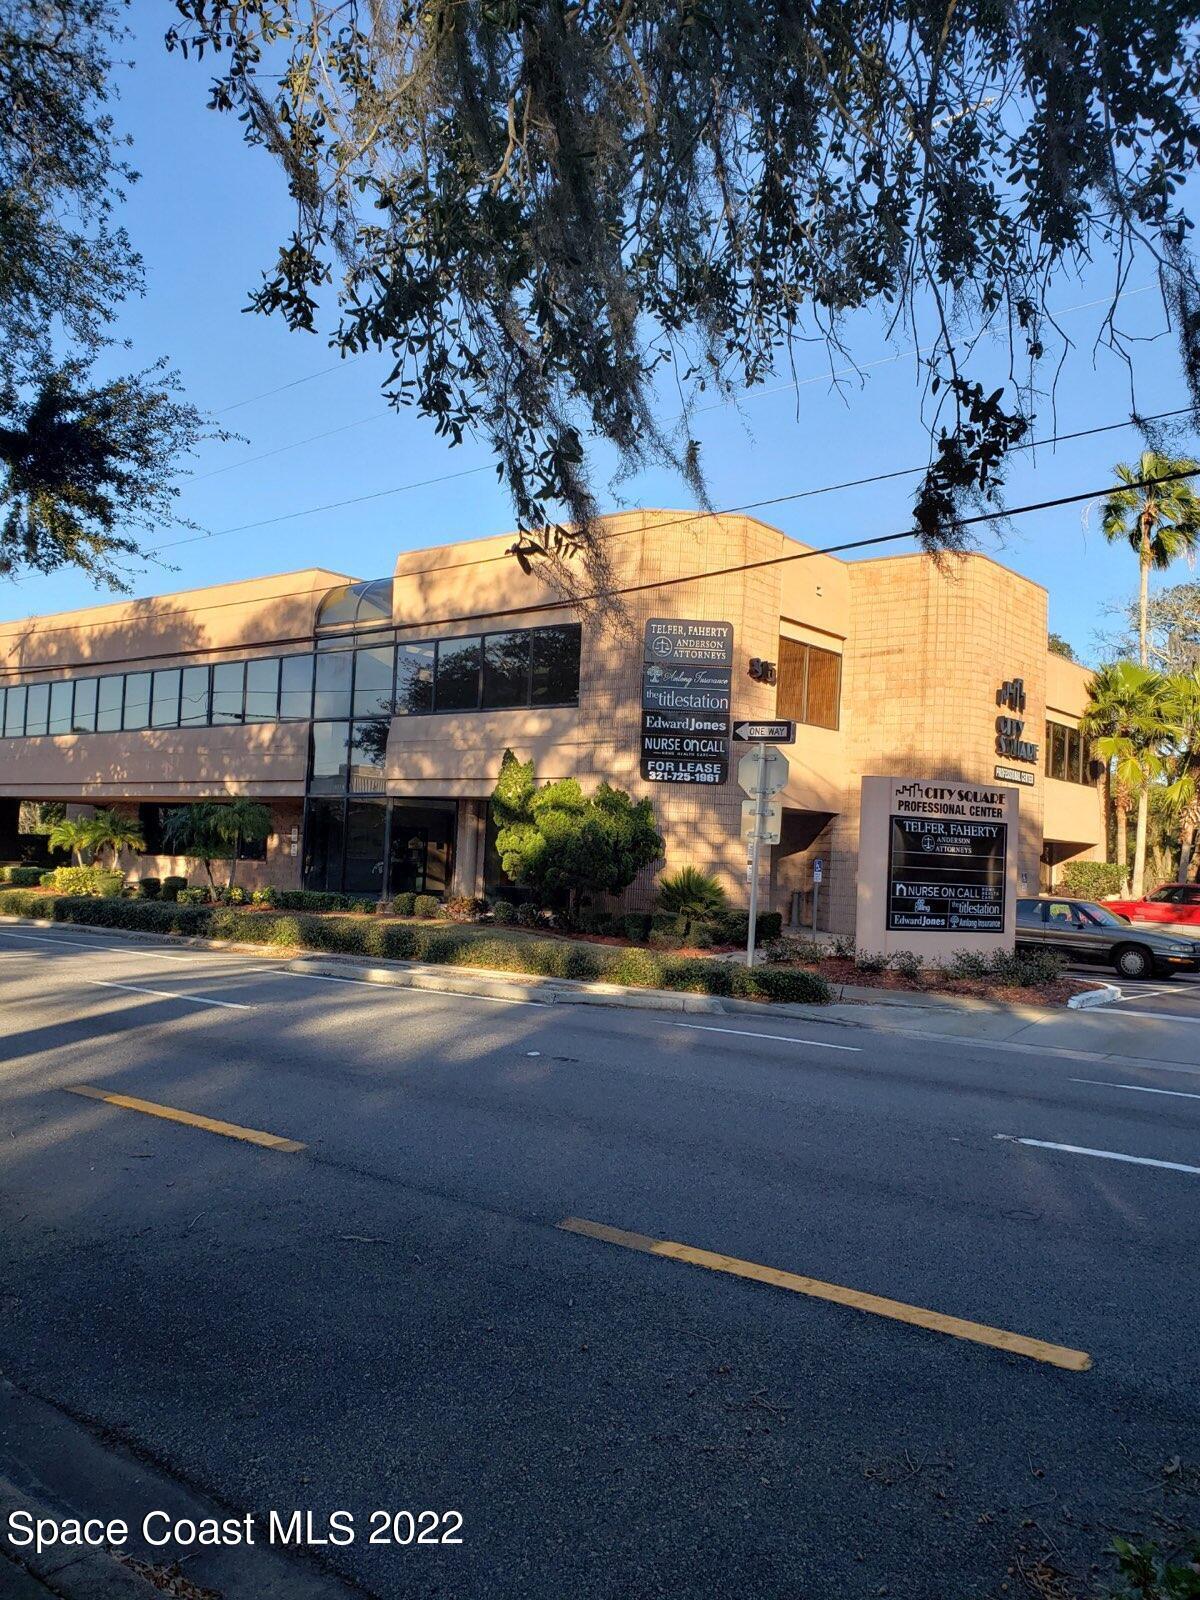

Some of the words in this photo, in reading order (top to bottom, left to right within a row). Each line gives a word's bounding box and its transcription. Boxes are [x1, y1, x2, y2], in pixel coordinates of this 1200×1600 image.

[651, 624, 686, 637] TELFER,
[688, 626, 729, 637] FAHERTY
[676, 639, 723, 648] ANDERSON
[673, 650, 726, 660] ATTORNEYS
[749, 727, 766, 736] ONE
[768, 727, 785, 736] WAY
[645, 737, 680, 751] NURSE
[647, 761, 675, 771] FOR
[679, 762, 721, 774] LEASE
[925, 787, 956, 801] CITY
[958, 790, 1006, 805] SQUARE
[898, 800, 966, 816] PROFESSIONAL
[969, 805, 1003, 818] CENTER
[903, 820, 947, 835] TELFER,
[950, 824, 998, 838] FAHERTY
[936, 836, 971, 844] ANDERSON
[935, 845, 972, 854] ATTORNEYS
[908, 886, 939, 897] NURSE
[941, 887, 955, 897] ON
[957, 888, 980, 898] CALL
